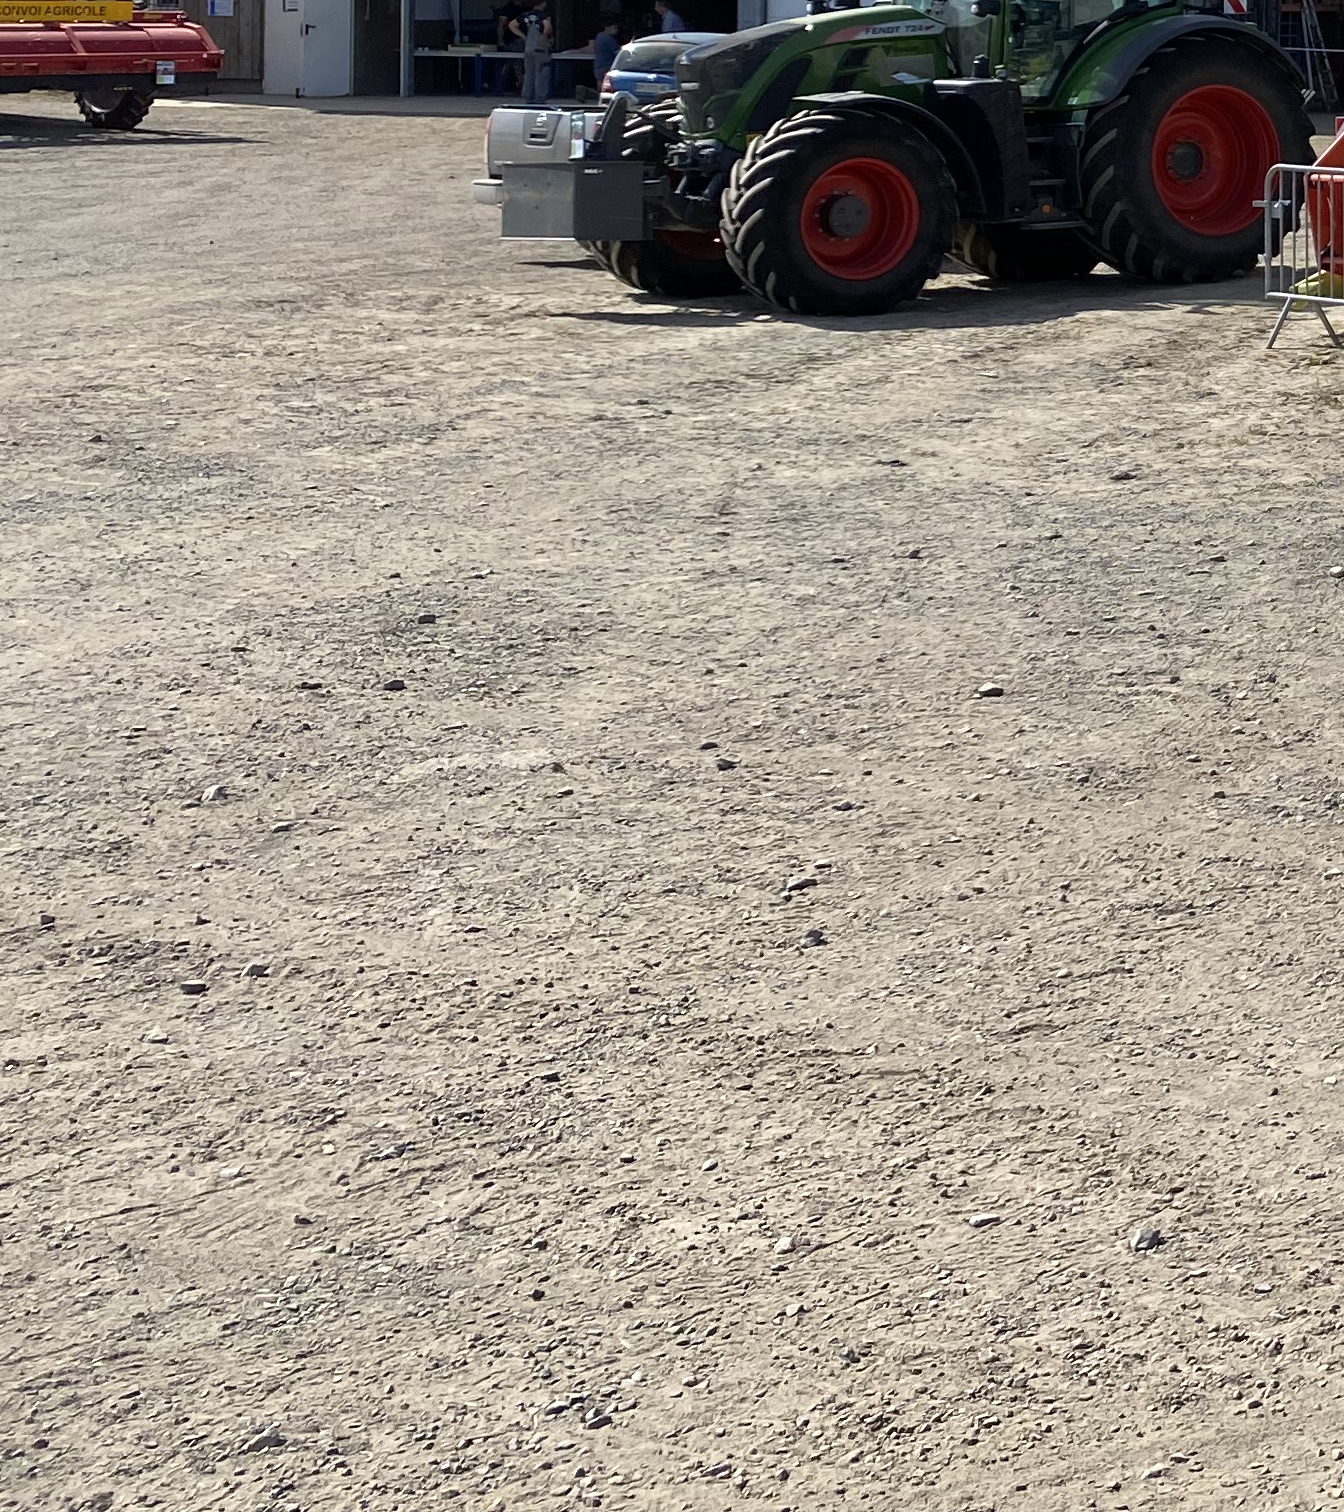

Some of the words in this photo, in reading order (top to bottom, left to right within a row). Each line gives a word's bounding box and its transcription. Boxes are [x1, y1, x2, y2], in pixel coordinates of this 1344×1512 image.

[0, 5, 40, 16] ONVOI
[43, 5, 107, 16] AGRICOLE
[864, 26, 901, 35] FENDT
